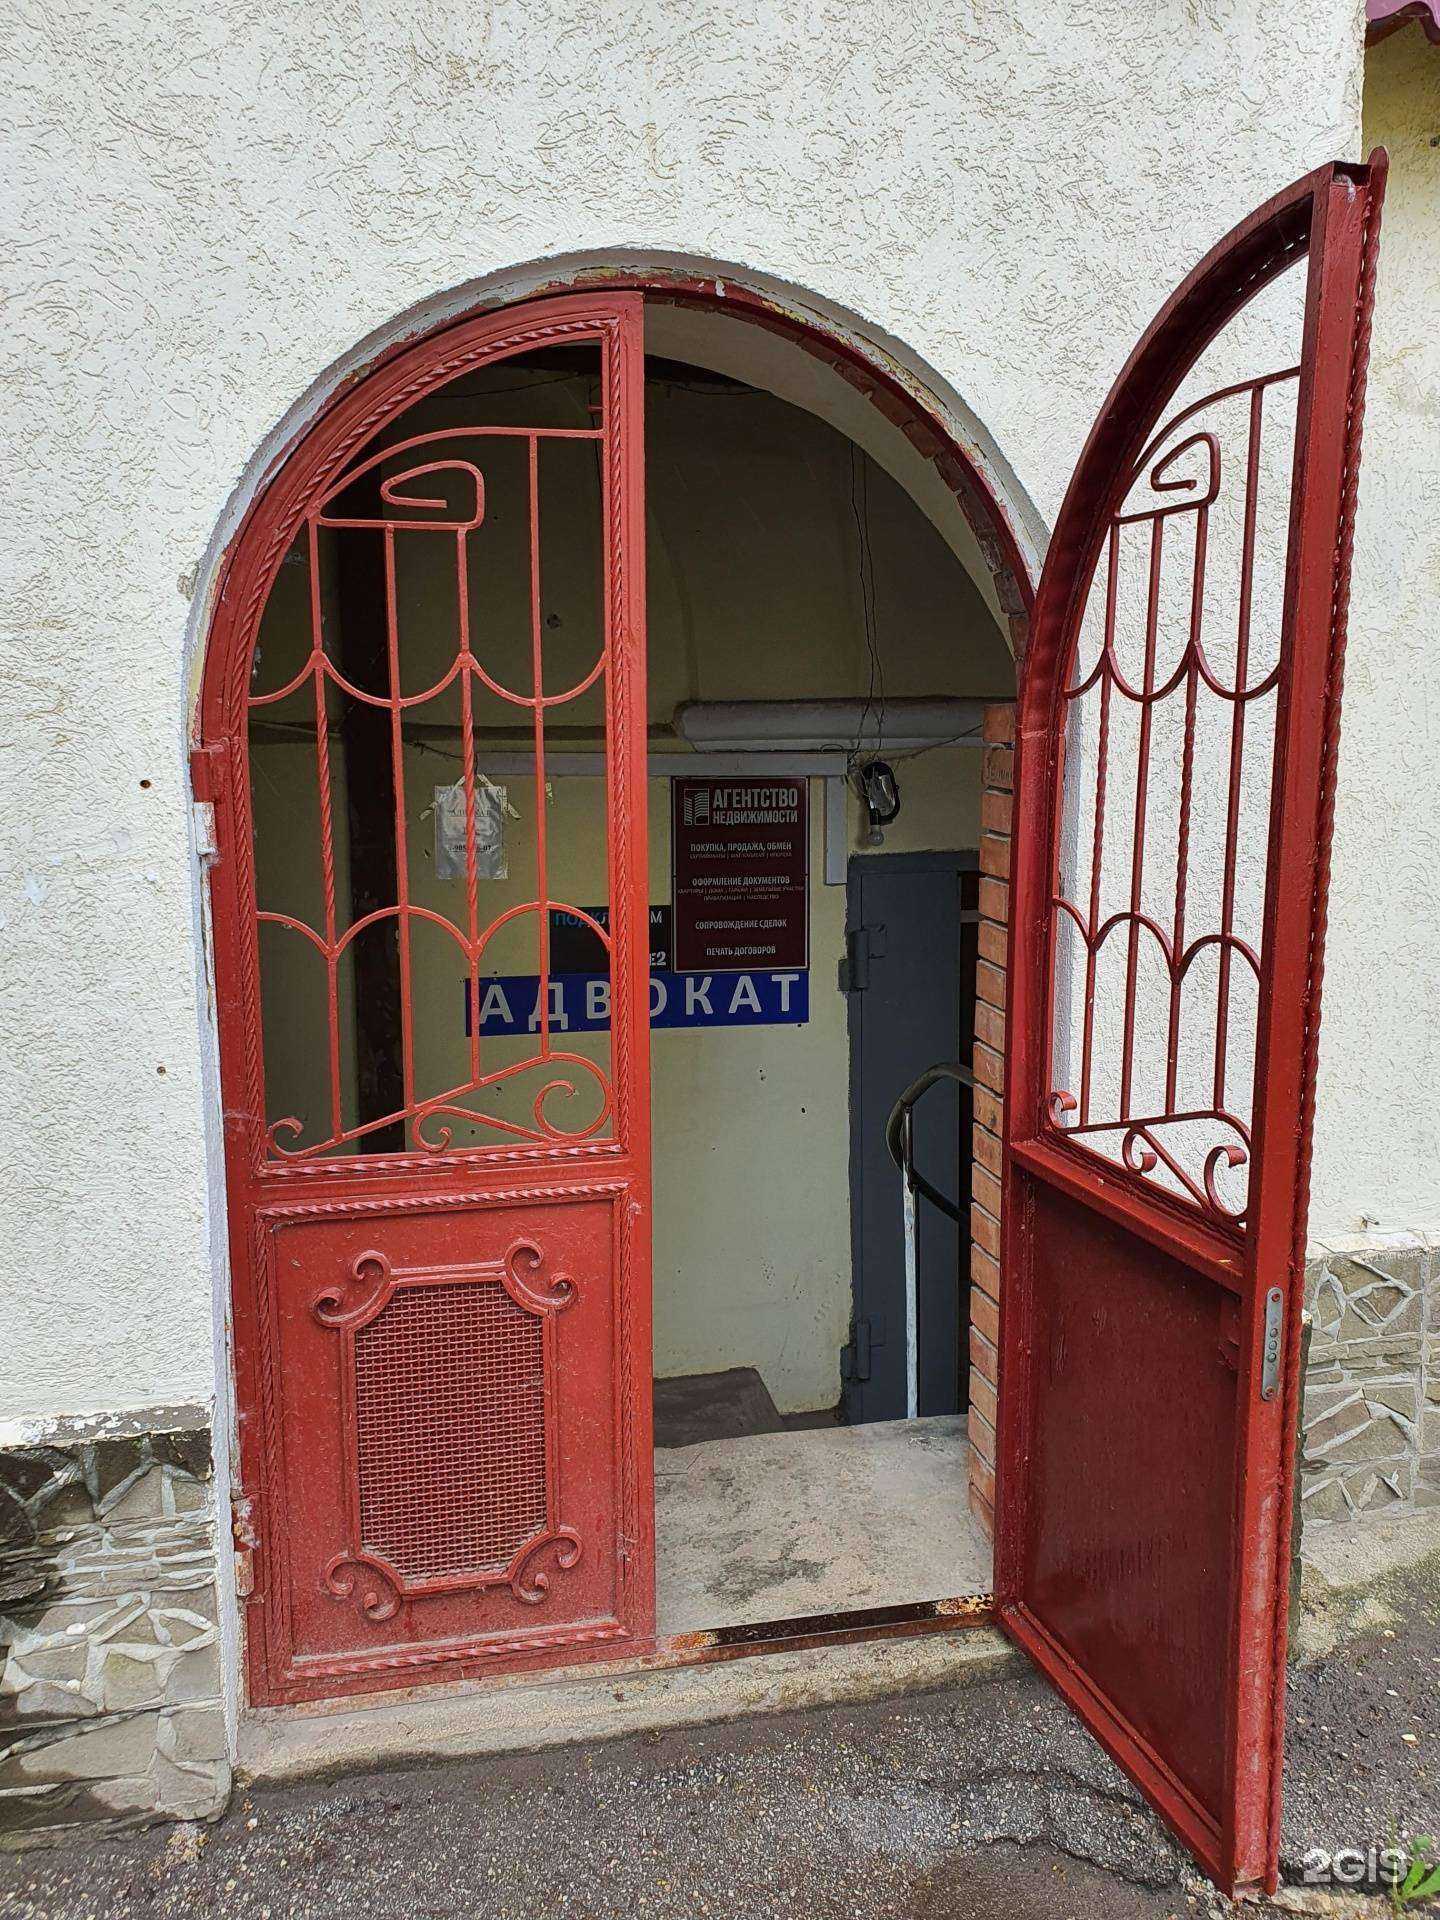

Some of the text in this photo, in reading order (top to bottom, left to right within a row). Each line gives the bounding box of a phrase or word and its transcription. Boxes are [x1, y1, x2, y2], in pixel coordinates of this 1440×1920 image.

[713, 787, 798, 808] АГЕНТСТВО
[713, 810, 798, 825] НЕДВИЖИМОСТИ
[690, 841, 792, 852] ПОКУПКА, ПРОДАЖА, ОБМЕН
[692, 876, 790, 886] ОФОРМЛЕНИЕ ДОКУМЕНТОВ
[695, 919, 787, 930] СОПРОВОЖДЕНИЕ СДЕЛОК
[706, 946, 776, 956] ПЕЧАТЬ ДОГОВОРОВ
